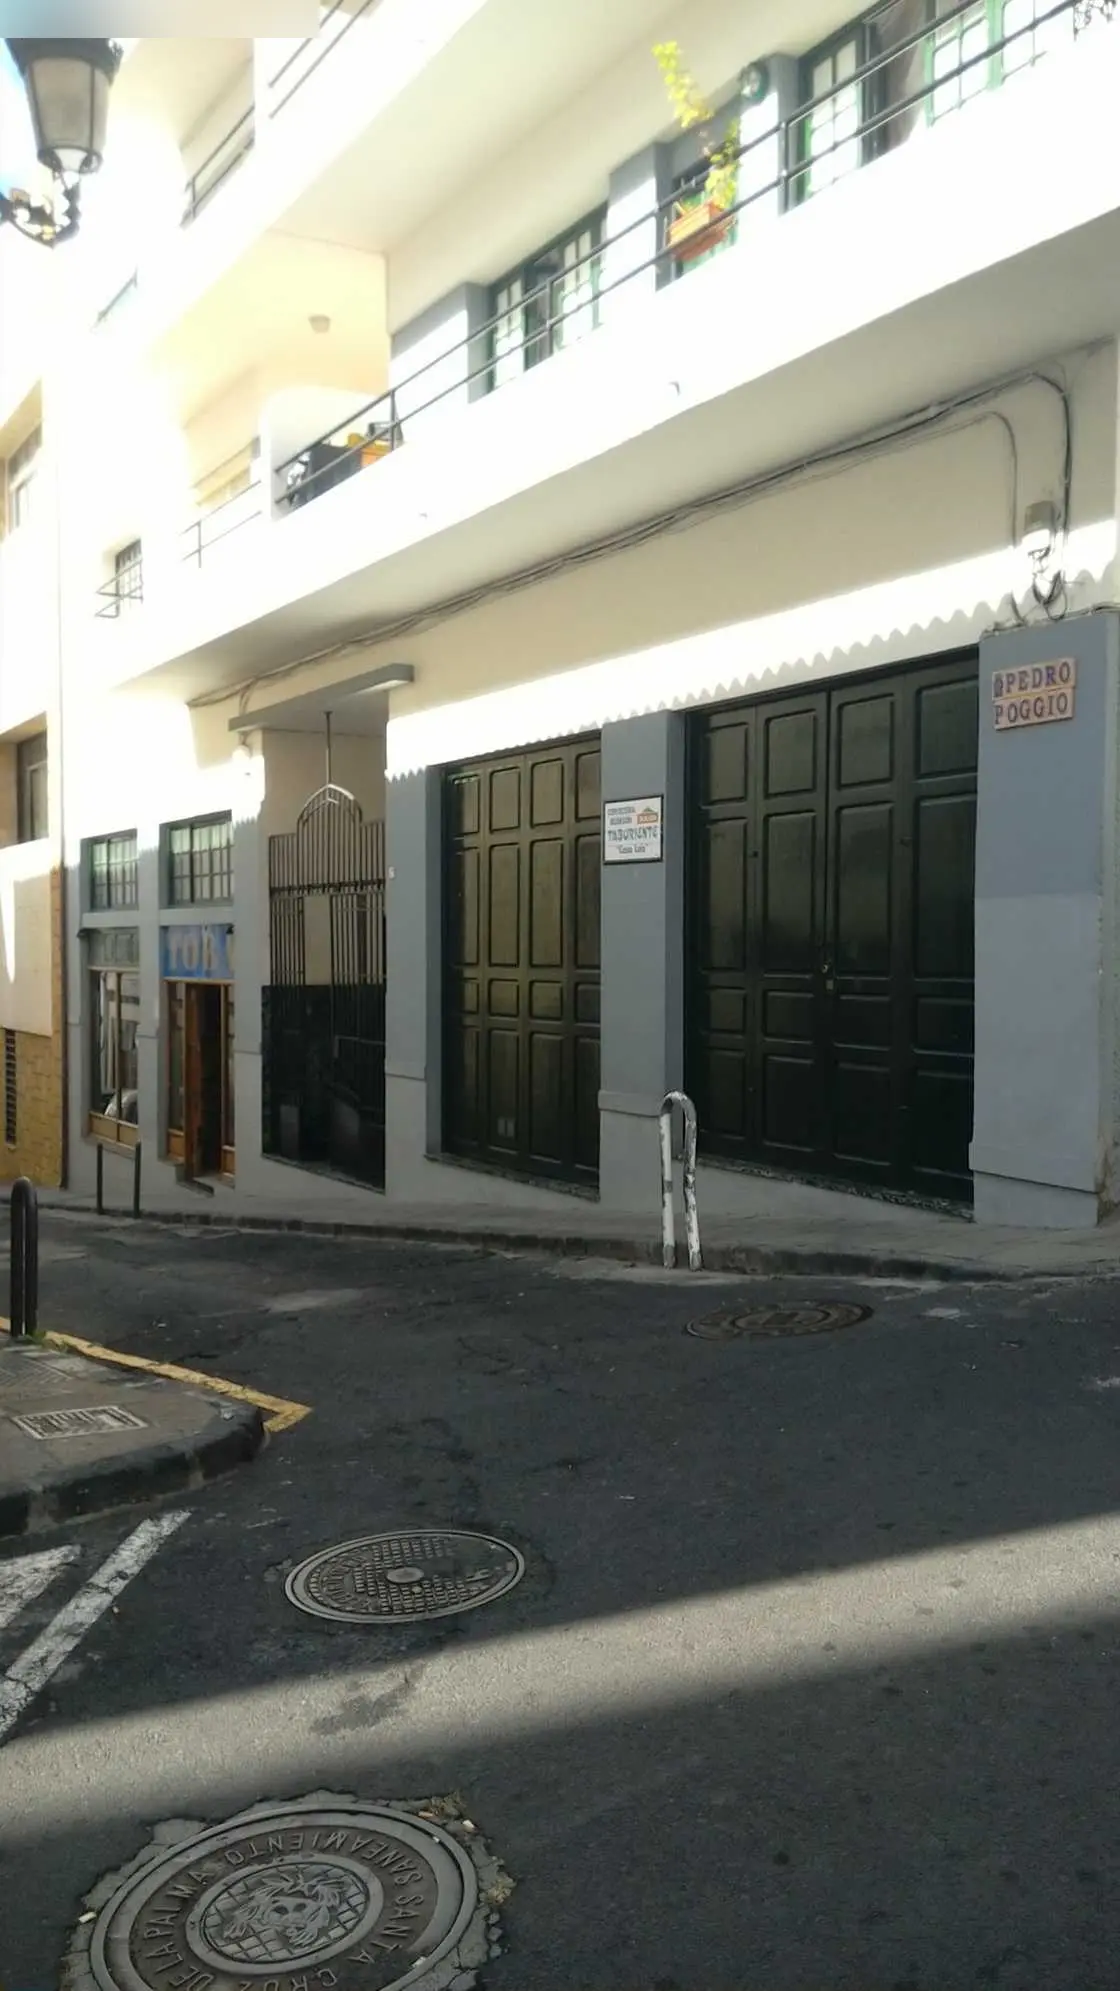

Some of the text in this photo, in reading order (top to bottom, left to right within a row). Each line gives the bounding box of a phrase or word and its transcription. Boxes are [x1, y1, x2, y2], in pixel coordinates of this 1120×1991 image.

[1005, 661, 1071, 693] PEDRO
[994, 692, 1068, 725] POGGIO
[224, 1831, 424, 1886] SANEAMIENTO
[346, 1894, 424, 1965] SANTA
